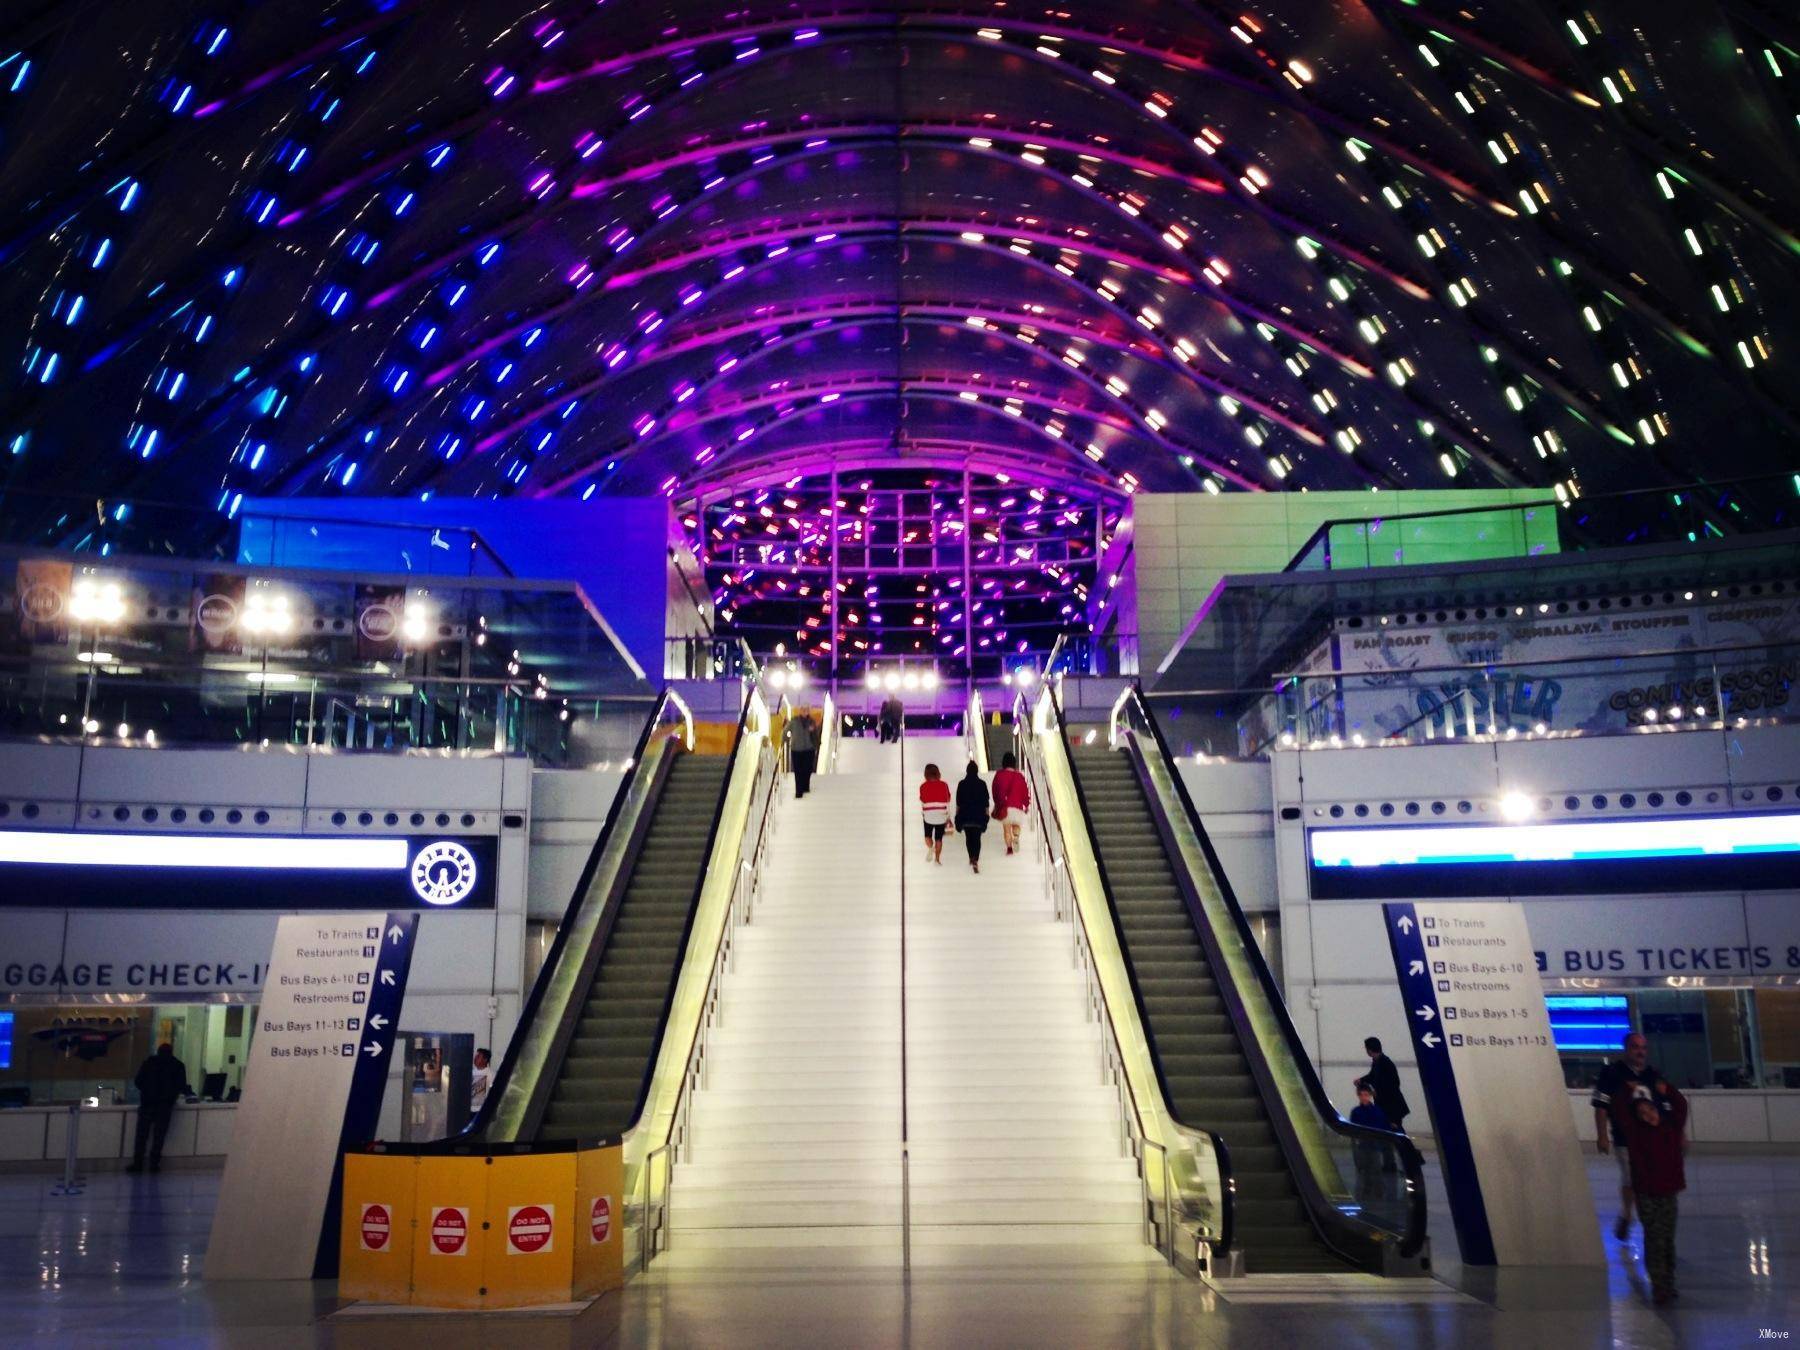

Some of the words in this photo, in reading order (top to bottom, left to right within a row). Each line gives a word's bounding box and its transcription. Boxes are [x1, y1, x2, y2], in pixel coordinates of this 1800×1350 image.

[1386, 634, 1432, 648] ROAST
[1609, 676, 1714, 711] COMING
[1720, 660, 1796, 692] SOON
[1417, 673, 1563, 728] OYSTER
[1729, 686, 1790, 713] 2015
[1439, 919, 1450, 929] To
[1454, 918, 1485, 929] Trains
[316, 930, 328, 940] To
[332, 929, 363, 940] Trains
[1443, 936, 1506, 946] Restaurants
[296, 948, 360, 958] Restaurants
[1564, 950, 1625, 972] BUS
[1637, 946, 1771, 970] TICKETS
[1787, 946, 1800, 967] &
[4, 963, 113, 986] GGAGE
[126, 963, 270, 986] CHECK-I
[1449, 963, 1469, 973] Bus
[1472, 963, 1497, 975] Bays
[1500, 963, 1524, 973] 6-10
[280, 975, 300, 985] Bus
[303, 975, 328, 986] Bays
[330, 974, 354, 984] 6-10
[1453, 981, 1511, 991] Restrooms
[292, 994, 350, 1004] Restrooms
[1460, 1008, 1480, 1018] Bus
[1483, 1008, 1508, 1019] Bays
[1511, 1008, 1528, 1018] 1-5
[263, 1022, 284, 1032] Bus
[286, 1021, 312, 1033] Bays
[315, 1020, 345, 1031] 11-13
[1466, 1036, 1487, 1046] Bus
[1489, 1036, 1514, 1047] Bays
[1517, 1036, 1548, 1046] 11-13
[270, 1047, 291, 1057] Bus
[293, 1047, 319, 1058] Bays
[322, 1045, 339, 1056] 1-5
[518, 1234, 543, 1243] ENTER
